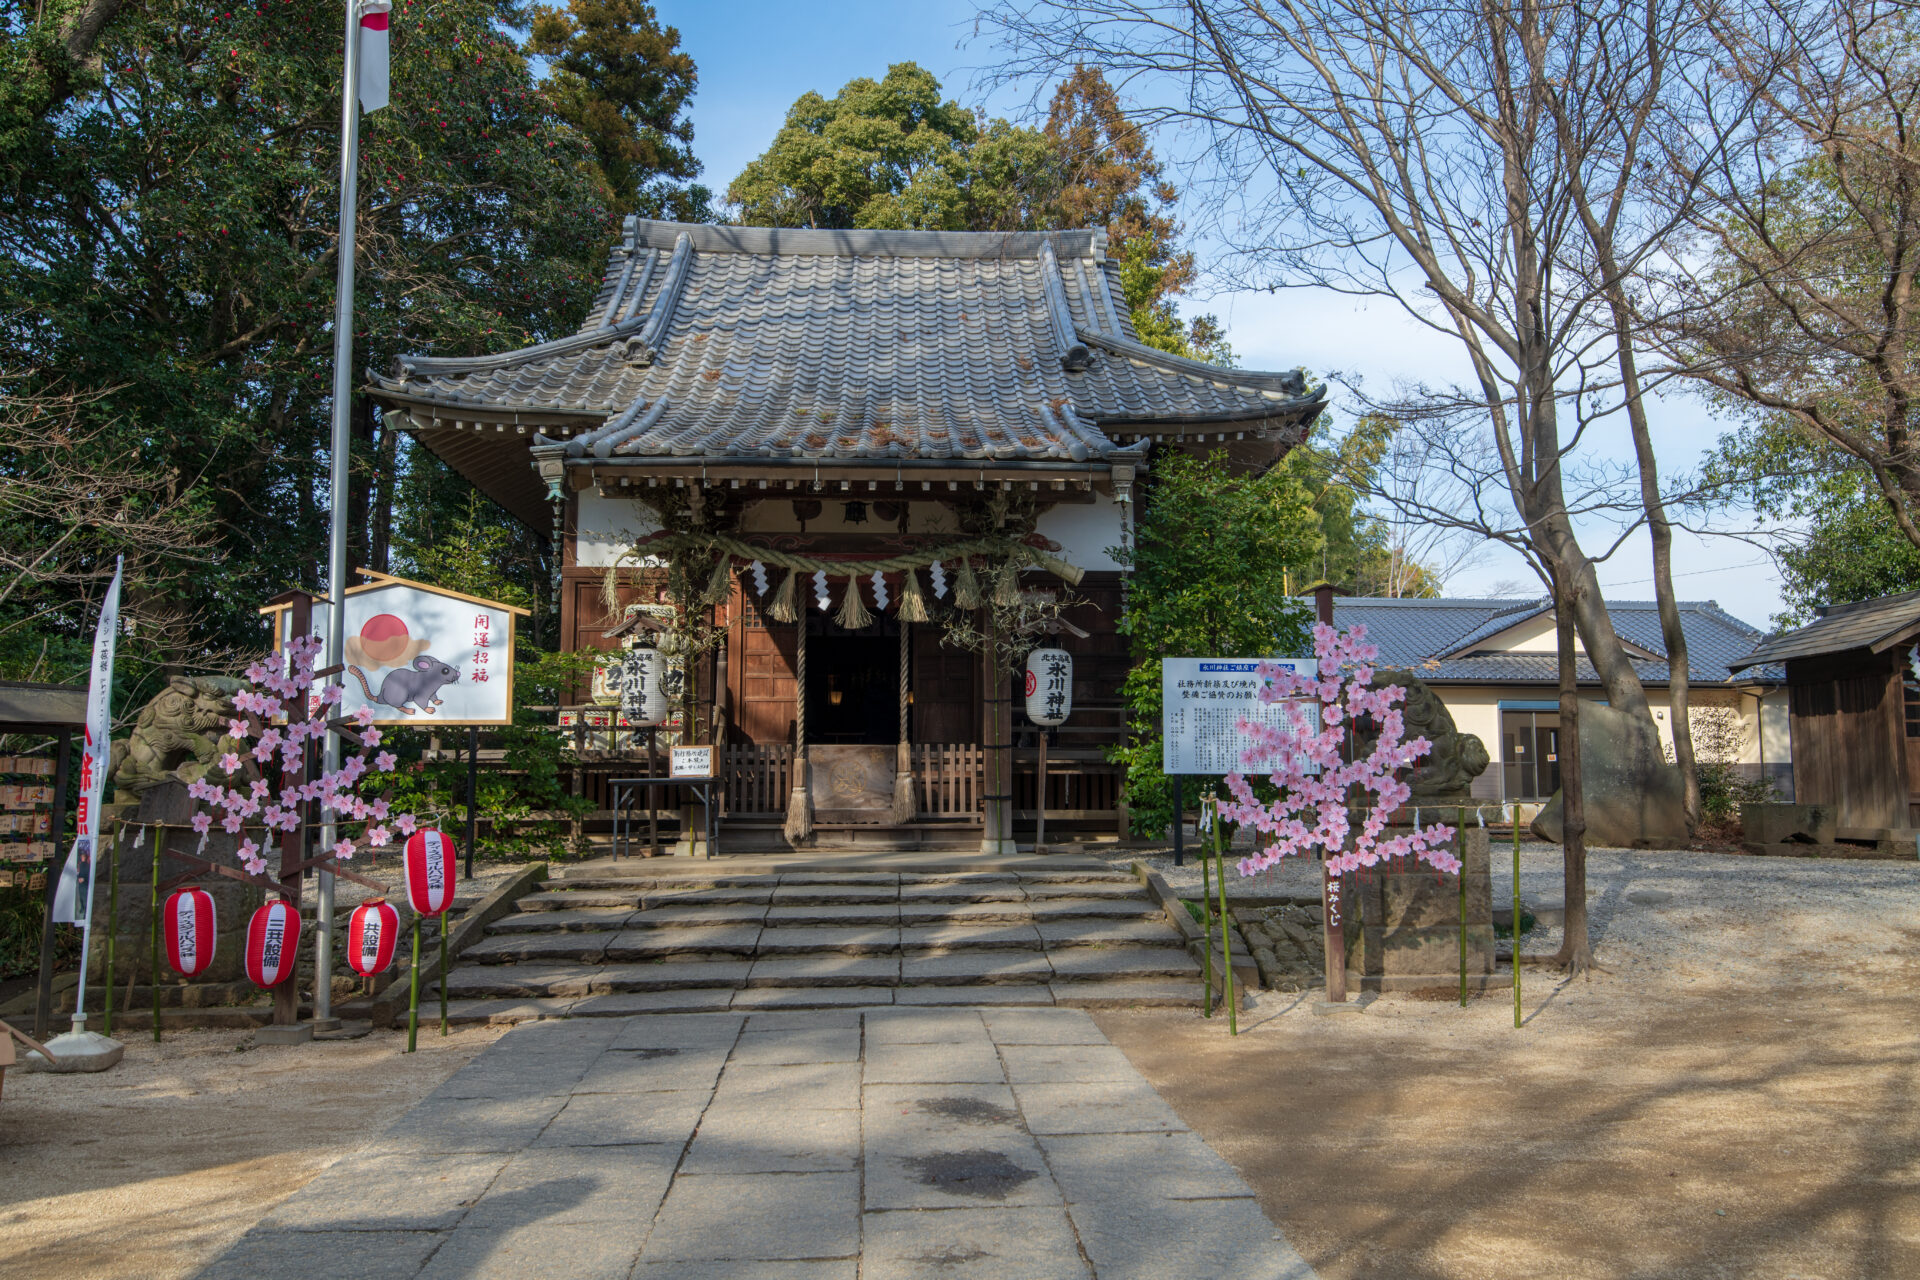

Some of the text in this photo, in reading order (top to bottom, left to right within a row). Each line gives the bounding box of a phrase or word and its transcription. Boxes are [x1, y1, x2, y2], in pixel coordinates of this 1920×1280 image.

[471, 613, 491, 683] 開運招福
[1041, 654, 1070, 663] 北本高尾
[626, 661, 650, 721] 氷川神社
[1042, 662, 1068, 720] 氷川神社
[1177, 680, 1257, 689] 社務所新築及び境内
[1327, 881, 1341, 927] 桜みくじ
[263, 919, 285, 968] 三共設備
